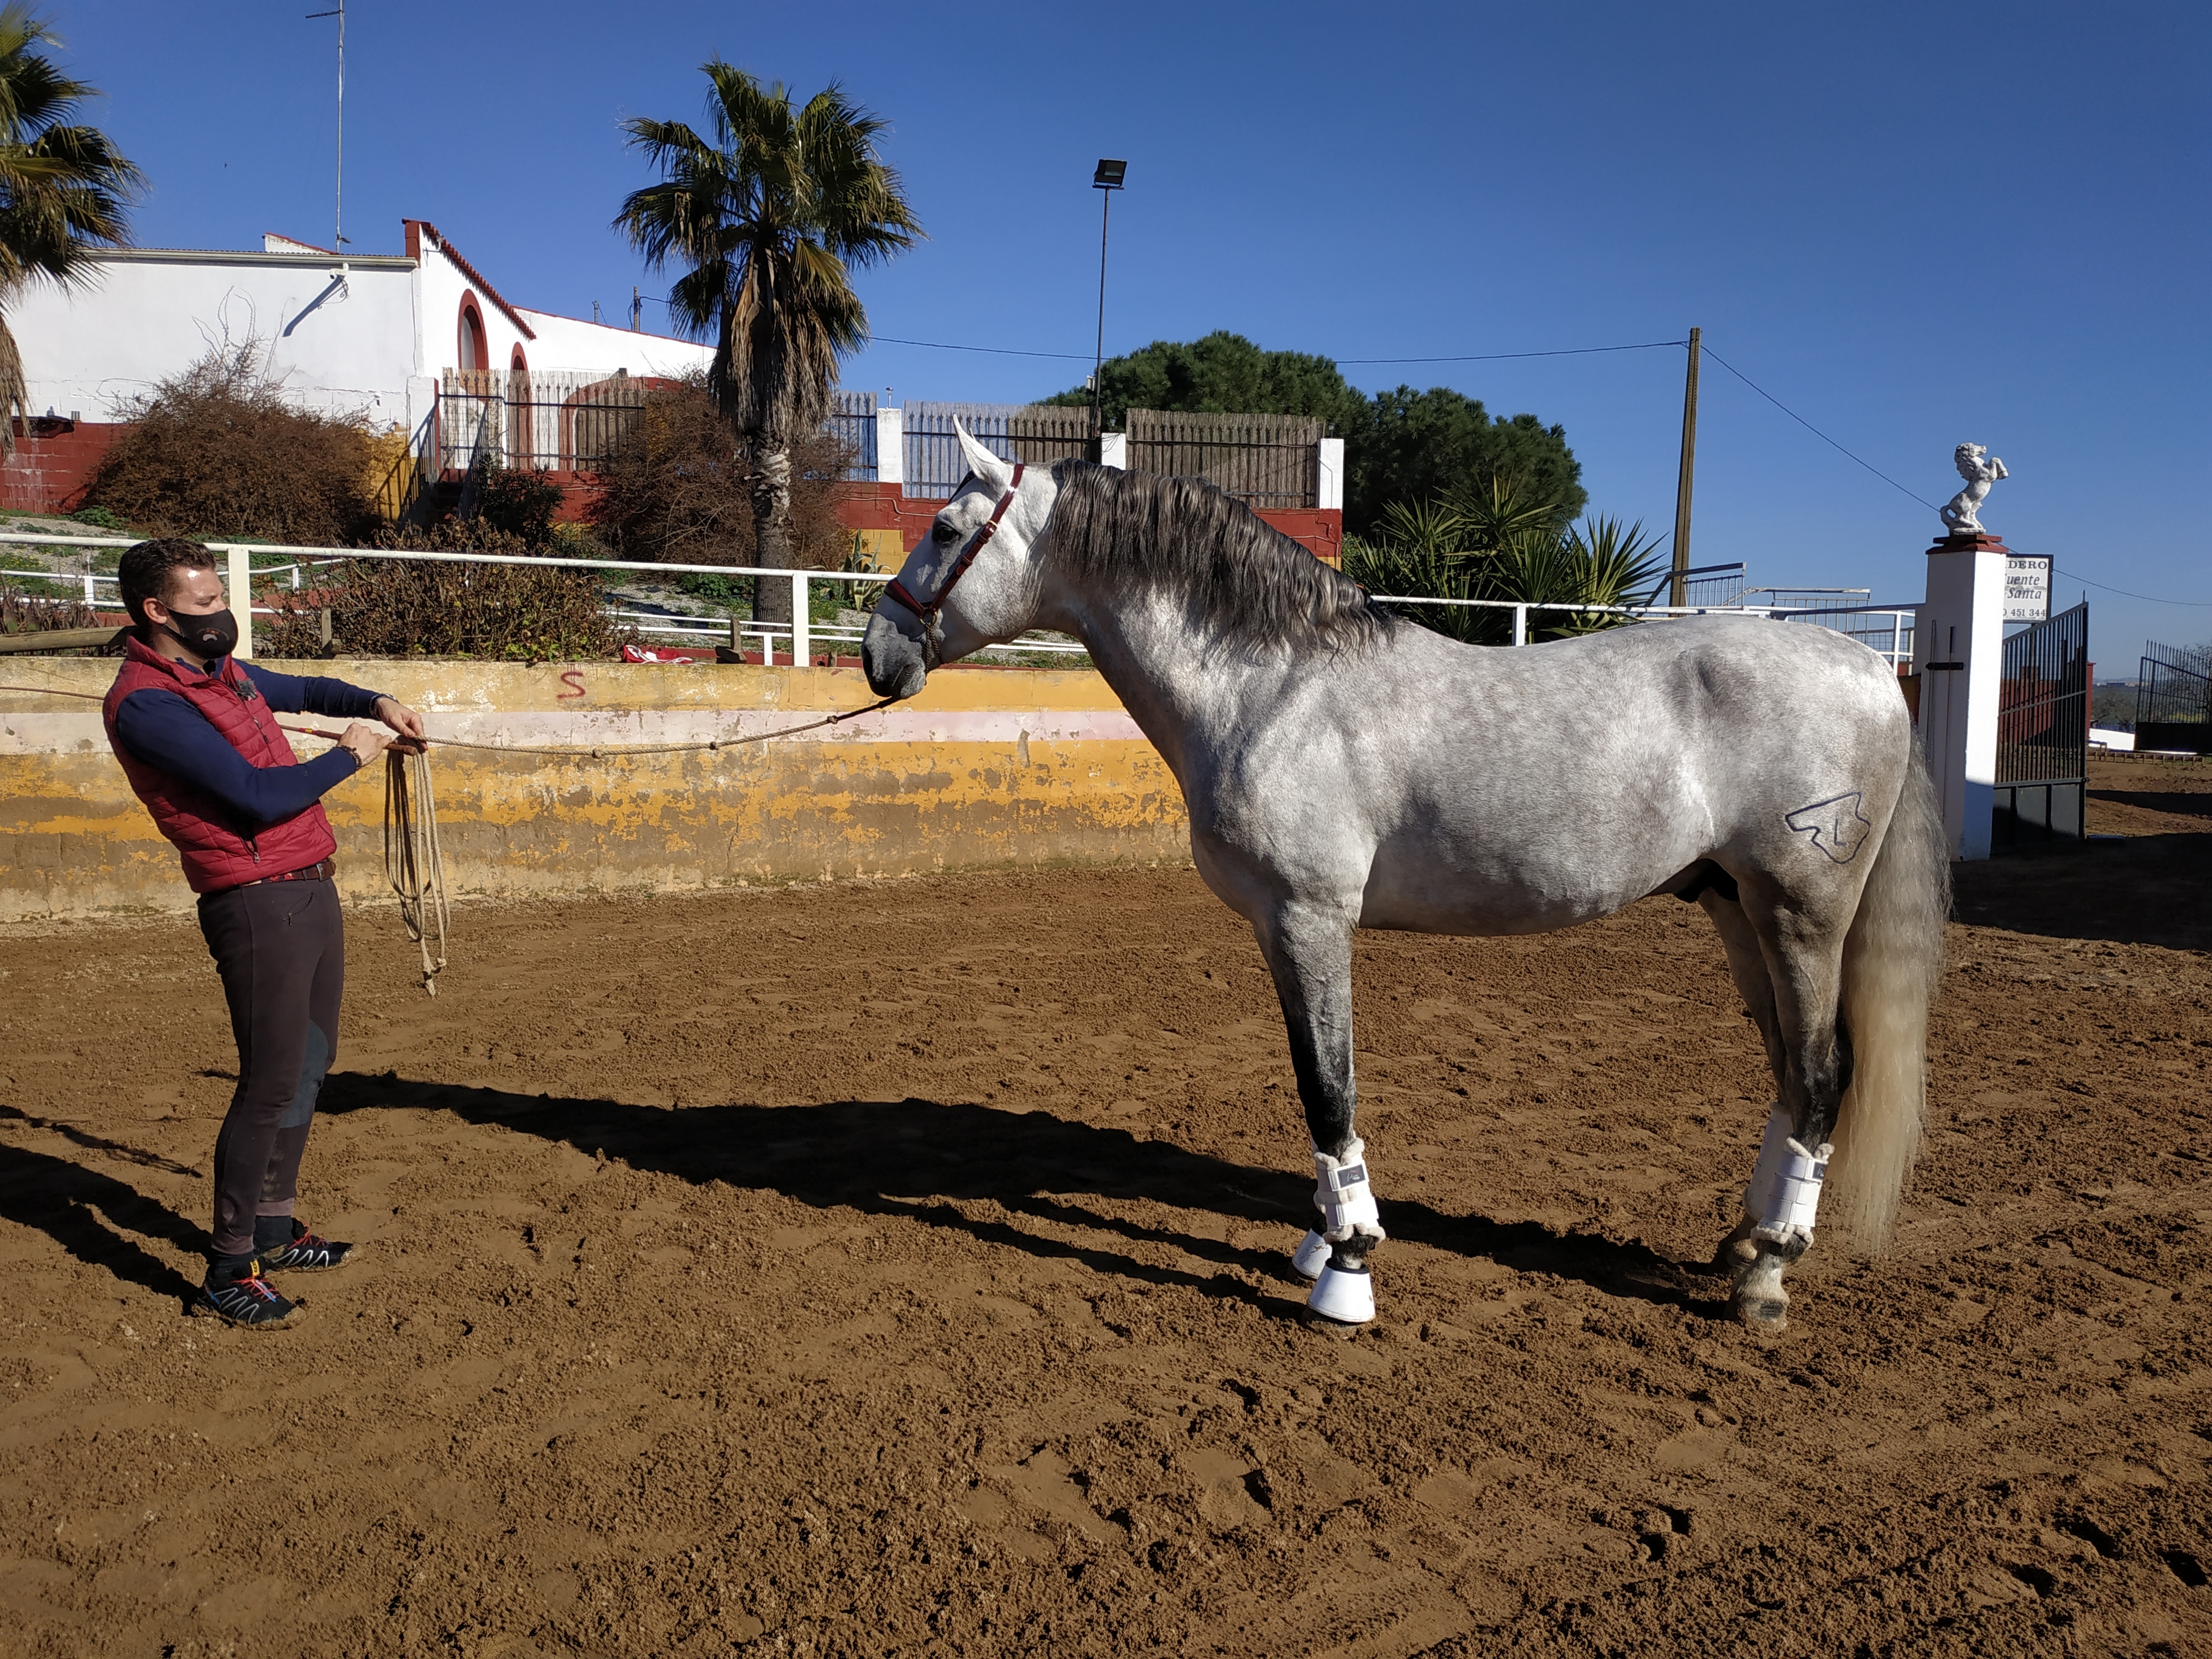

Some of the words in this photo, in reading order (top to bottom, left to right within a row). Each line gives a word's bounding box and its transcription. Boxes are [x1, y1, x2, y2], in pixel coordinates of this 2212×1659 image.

[2005, 560, 2047, 569] DERO
[2005, 573, 2040, 585] uente
[2011, 608, 2025, 617] 451
[2029, 608, 2045, 617] 344
[556, 671, 586, 698] S
